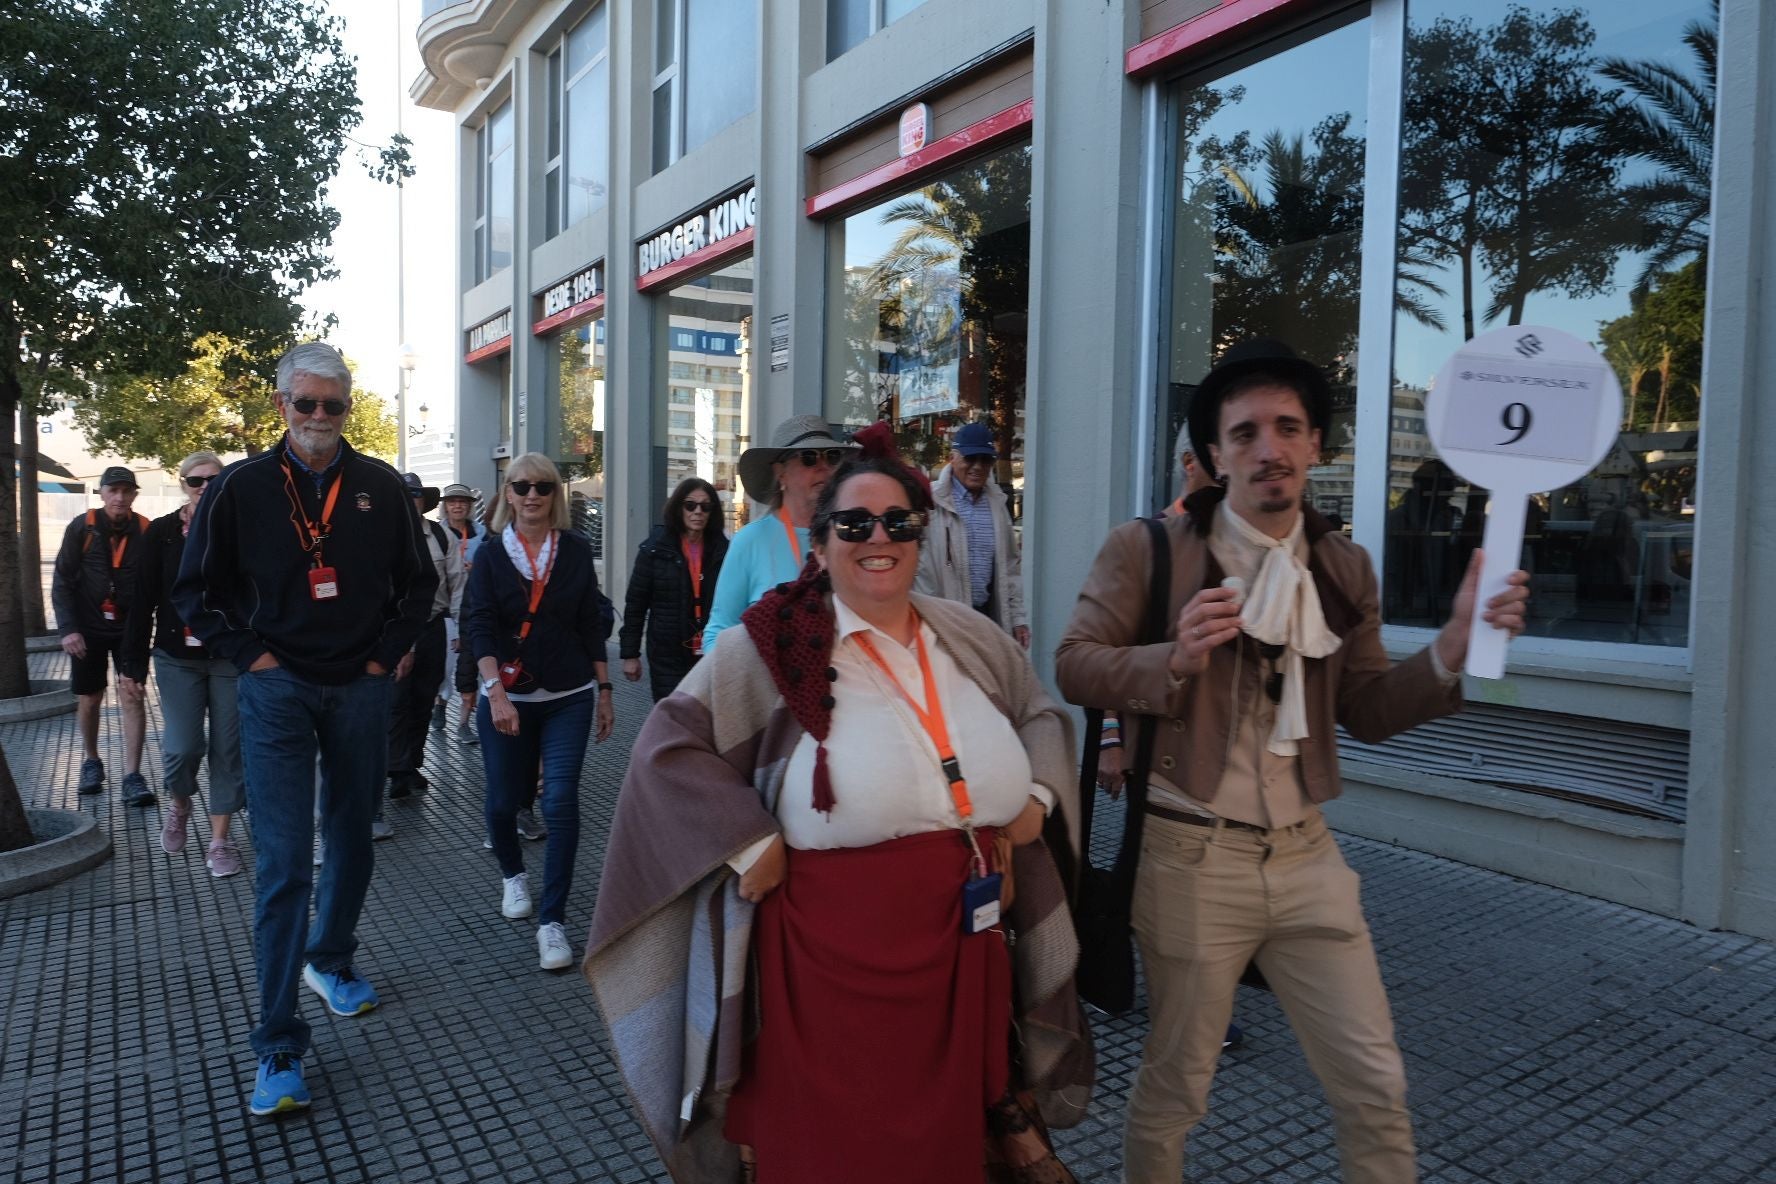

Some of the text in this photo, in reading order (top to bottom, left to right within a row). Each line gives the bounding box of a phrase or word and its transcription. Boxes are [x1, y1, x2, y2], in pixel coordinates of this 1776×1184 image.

[639, 186, 756, 277] BURGER KING
[544, 267, 597, 318] DESDE 1954
[1495, 402, 1532, 446] 9
